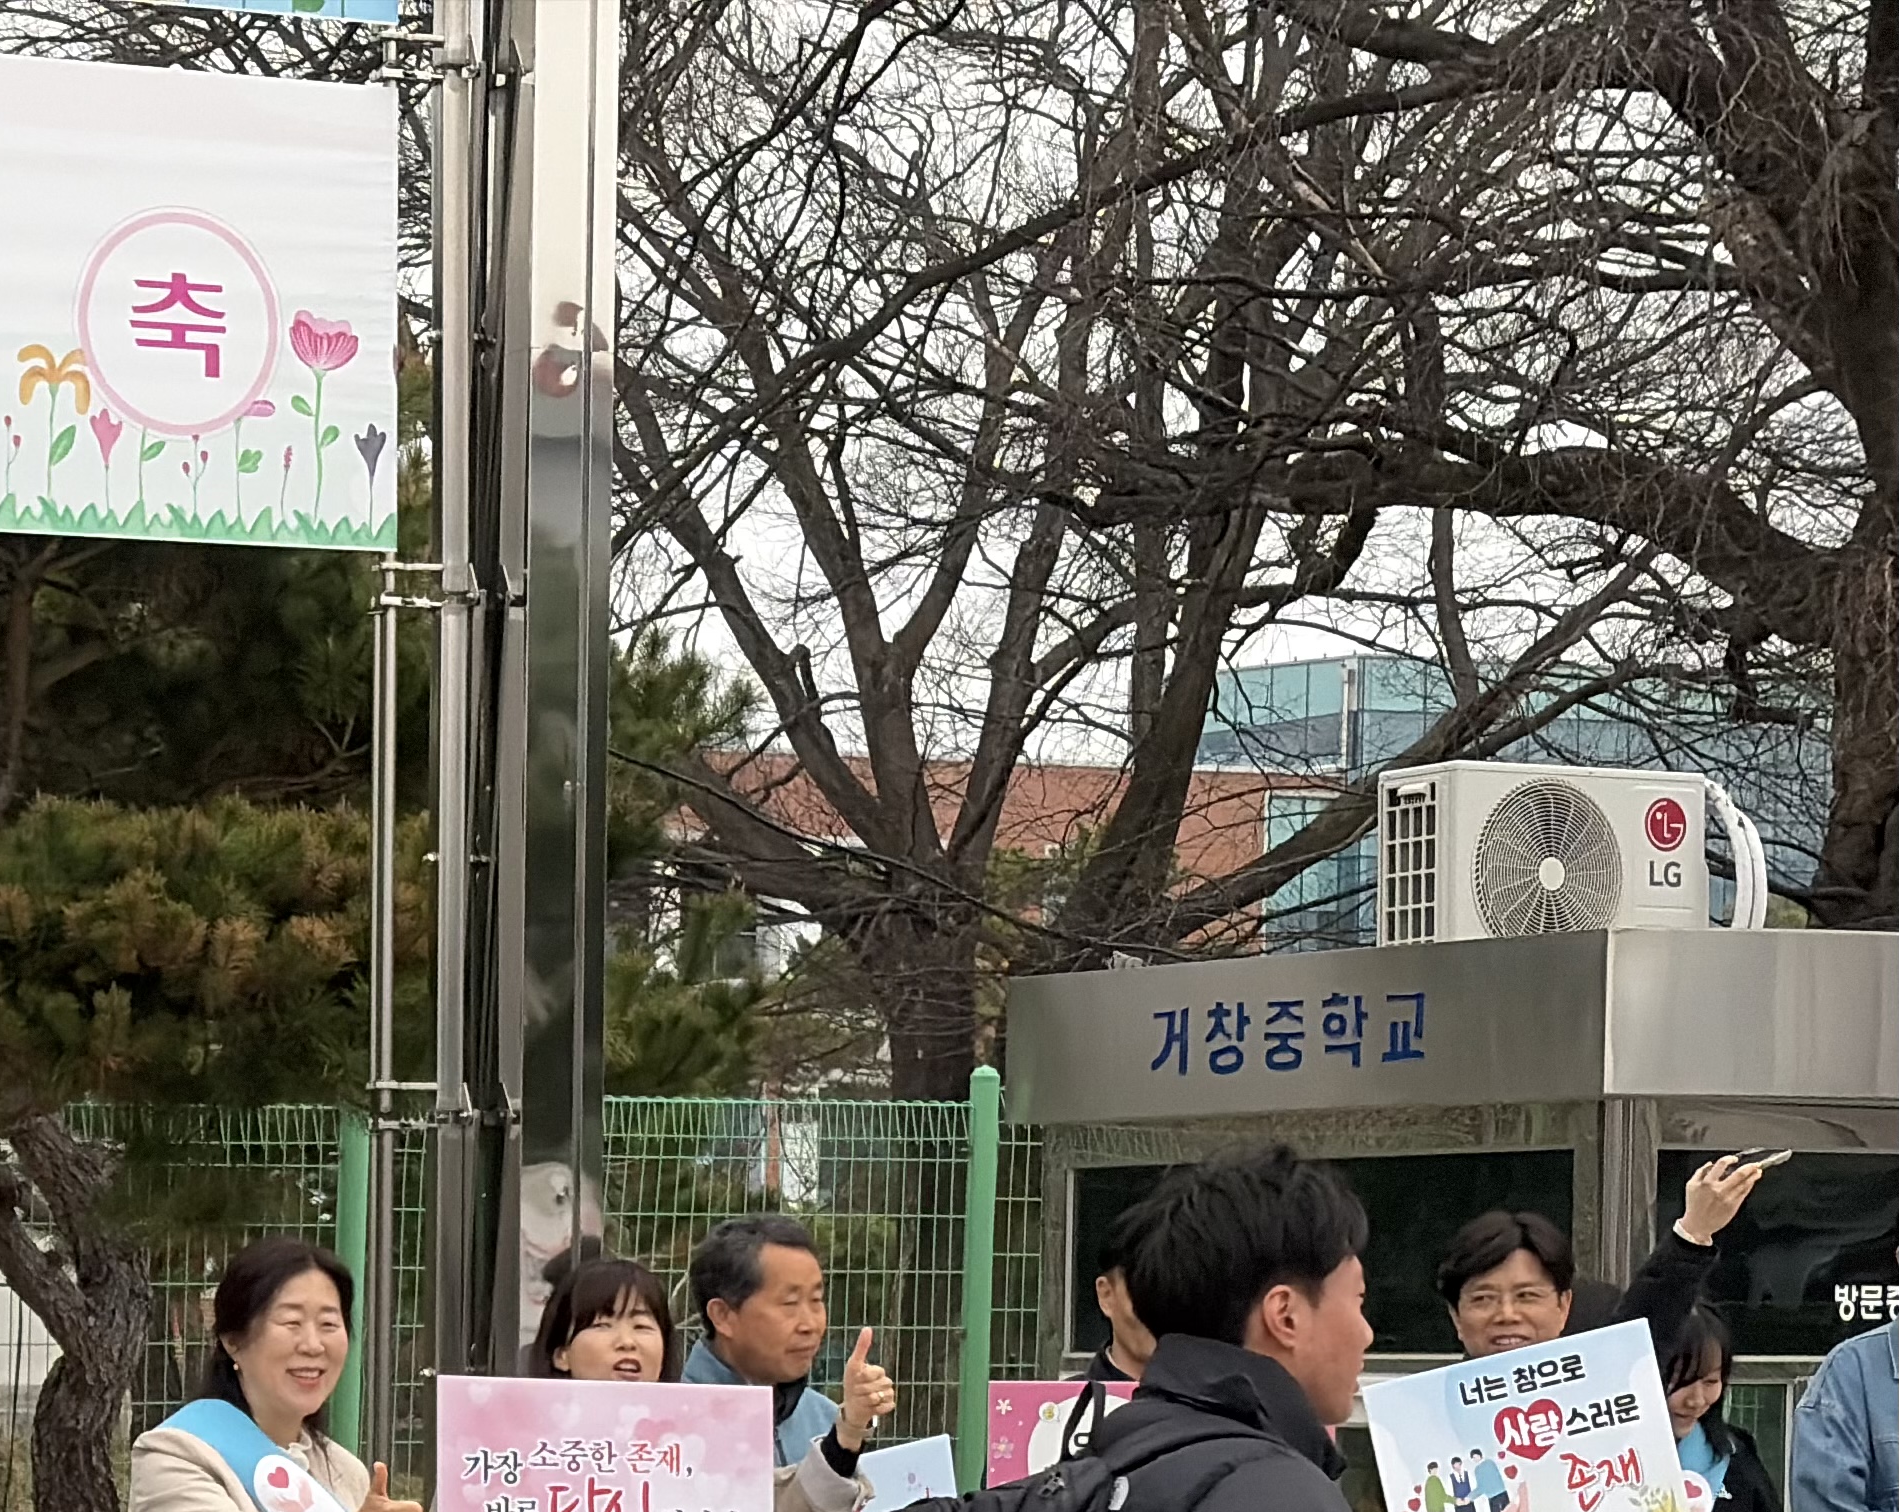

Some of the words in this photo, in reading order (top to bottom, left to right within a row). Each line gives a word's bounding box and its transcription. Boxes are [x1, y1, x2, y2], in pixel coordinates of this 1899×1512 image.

[128, 271, 227, 379] 축
[1649, 860, 1682, 888] LG
[1151, 990, 1427, 1077] 거창중학교
[1459, 1373, 1508, 1406] 너는
[1512, 1353, 1587, 1395] 참으로
[1500, 1392, 1641, 1449] 사랑스러운
[462, 1447, 524, 1485] 가장
[528, 1440, 616, 1474] 소중한
[623, 1442, 694, 1480] 존재,
[1559, 1447, 1644, 1512] 존재
